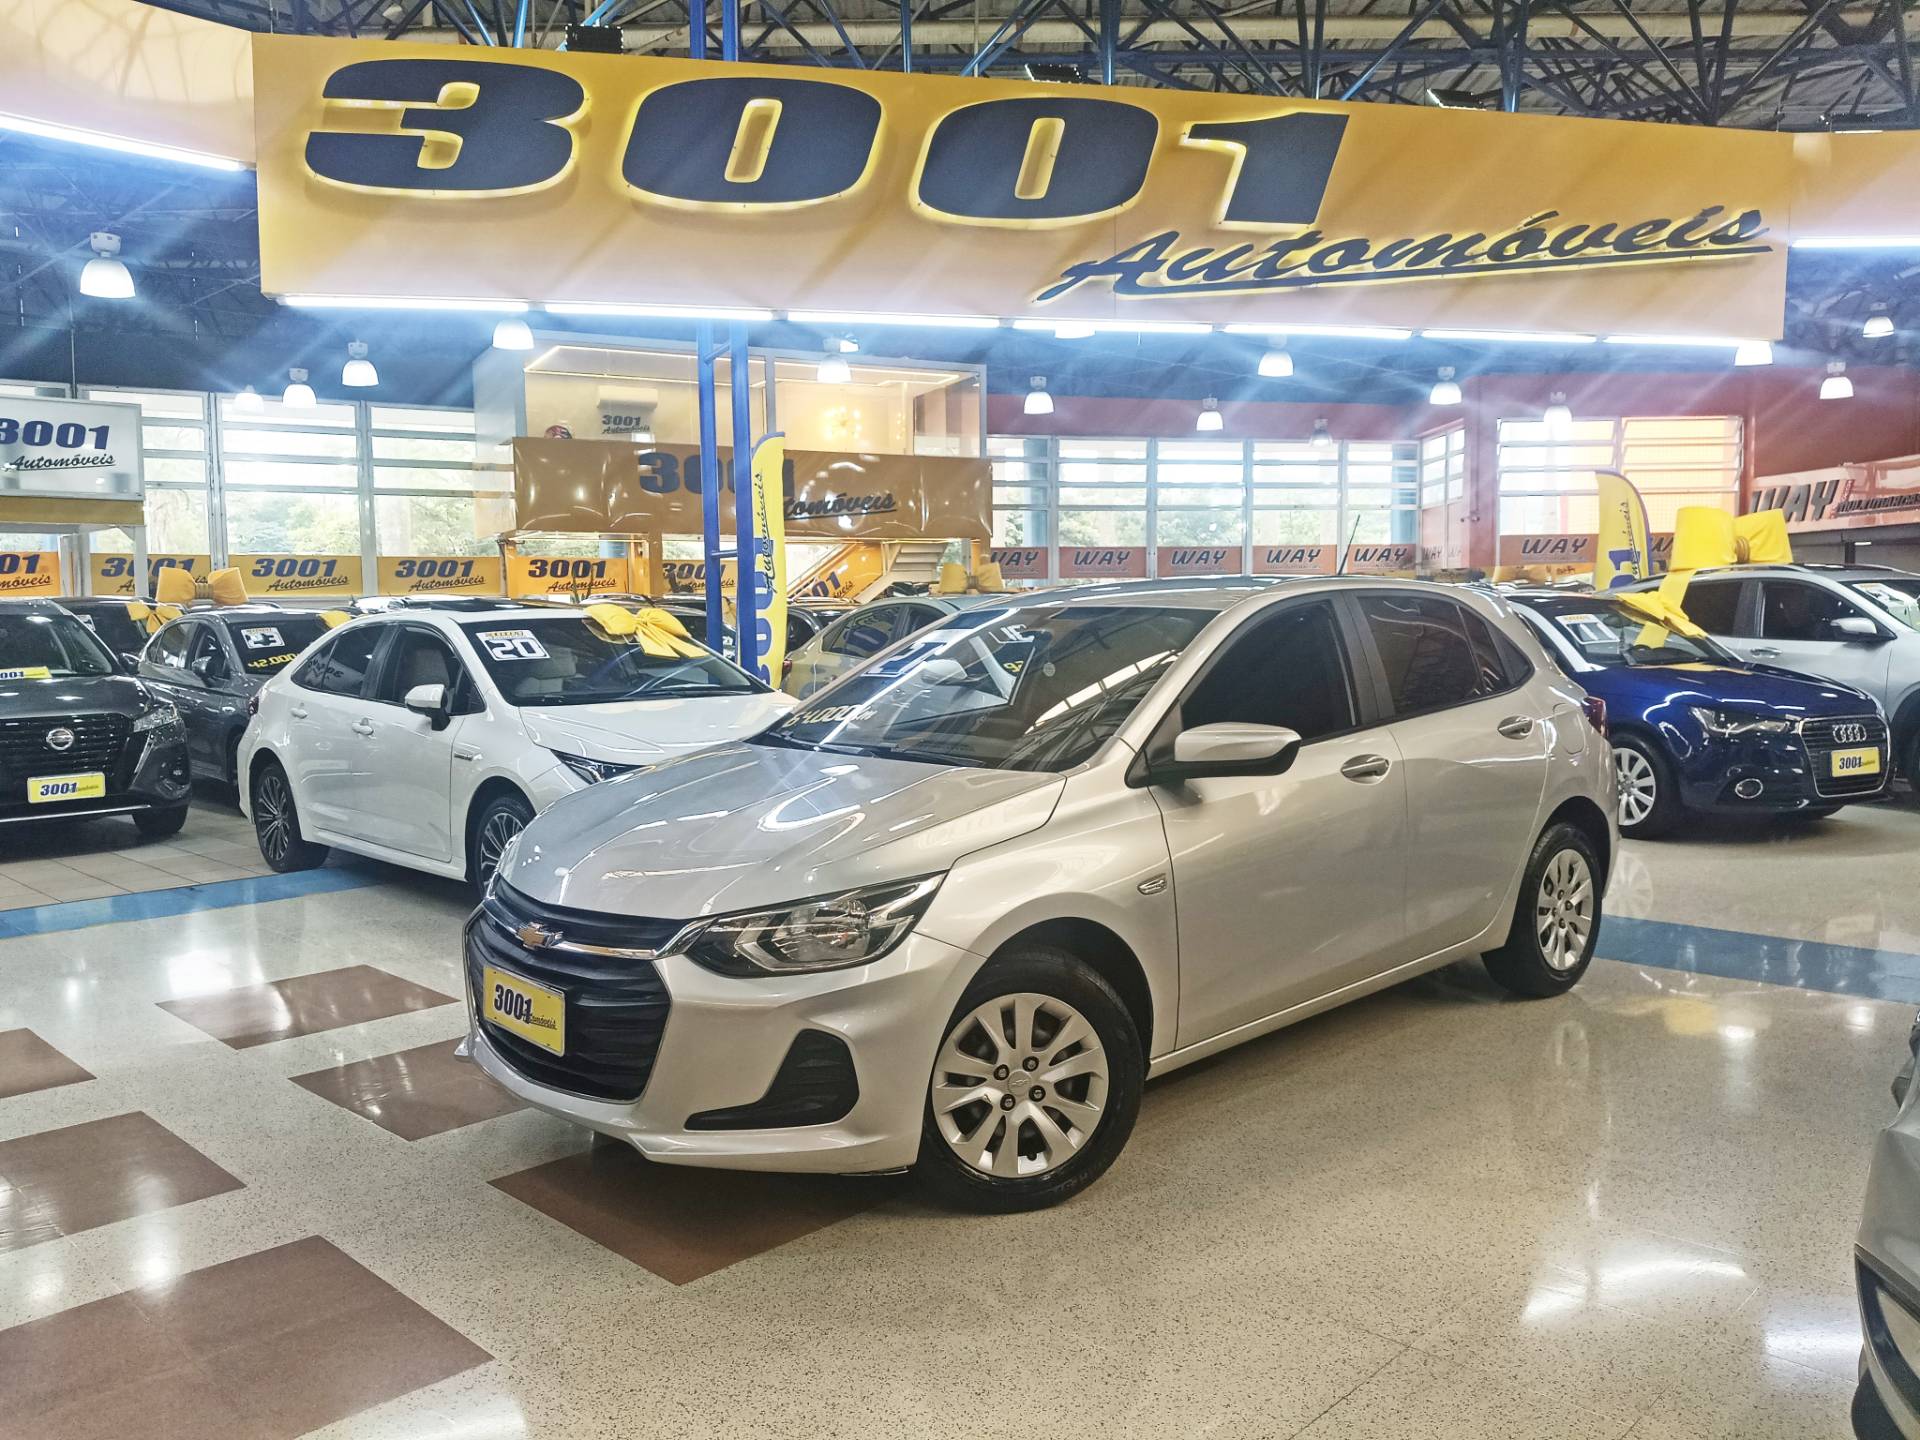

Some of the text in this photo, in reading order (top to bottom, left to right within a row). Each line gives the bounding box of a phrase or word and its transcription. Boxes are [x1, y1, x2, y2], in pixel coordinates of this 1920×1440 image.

[305, 59, 1349, 224] 3001
[1036, 206, 1772, 302] Automóveis
[602, 415, 641, 426] 3001
[0, 418, 110, 450] 3001
[5, 453, 116, 471] Automóveis
[1522, 538, 1588, 554] WAY
[1074, 551, 1130, 565] WAY
[1171, 550, 1227, 565] WAY
[1266, 549, 1321, 563] WAY
[1354, 548, 1407, 562] WAY
[252, 558, 337, 577] 3001
[395, 559, 474, 577] 3001
[528, 559, 606, 578] 3001
[266, 575, 350, 592] Automóveis
[408, 576, 486, 592] Automóveis
[492, 639, 546, 659] 20
[1839, 756, 1862, 769] 3001
[40, 783, 77, 796] 3001
[494, 983, 532, 1024] 3001
